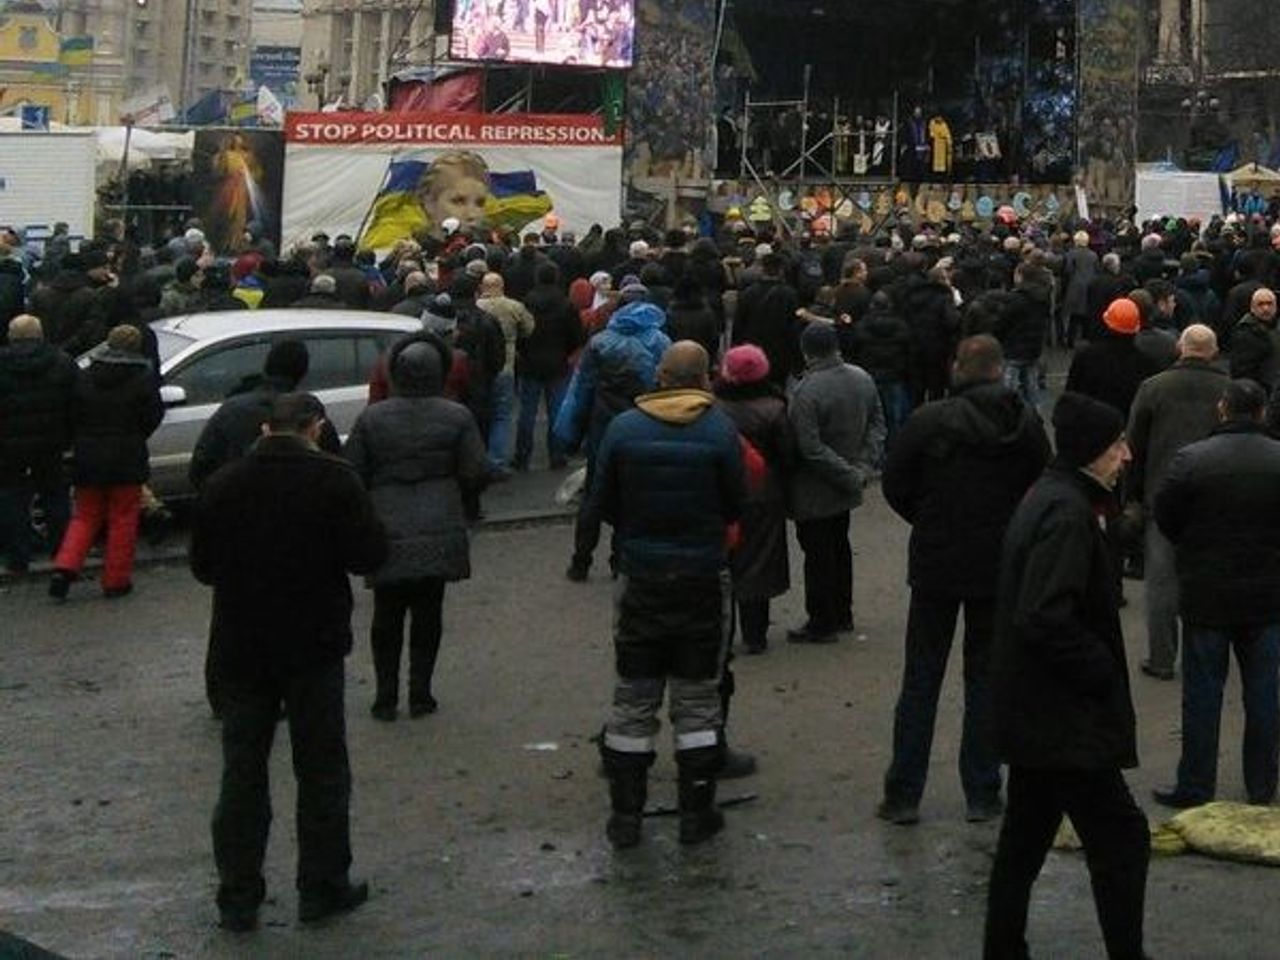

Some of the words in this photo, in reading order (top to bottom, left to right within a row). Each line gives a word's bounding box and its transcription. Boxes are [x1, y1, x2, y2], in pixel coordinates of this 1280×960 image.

[295, 122, 356, 139] STOP
[361, 122, 476, 140] POLITICAL
[480, 124, 615, 141] REPRESSION
